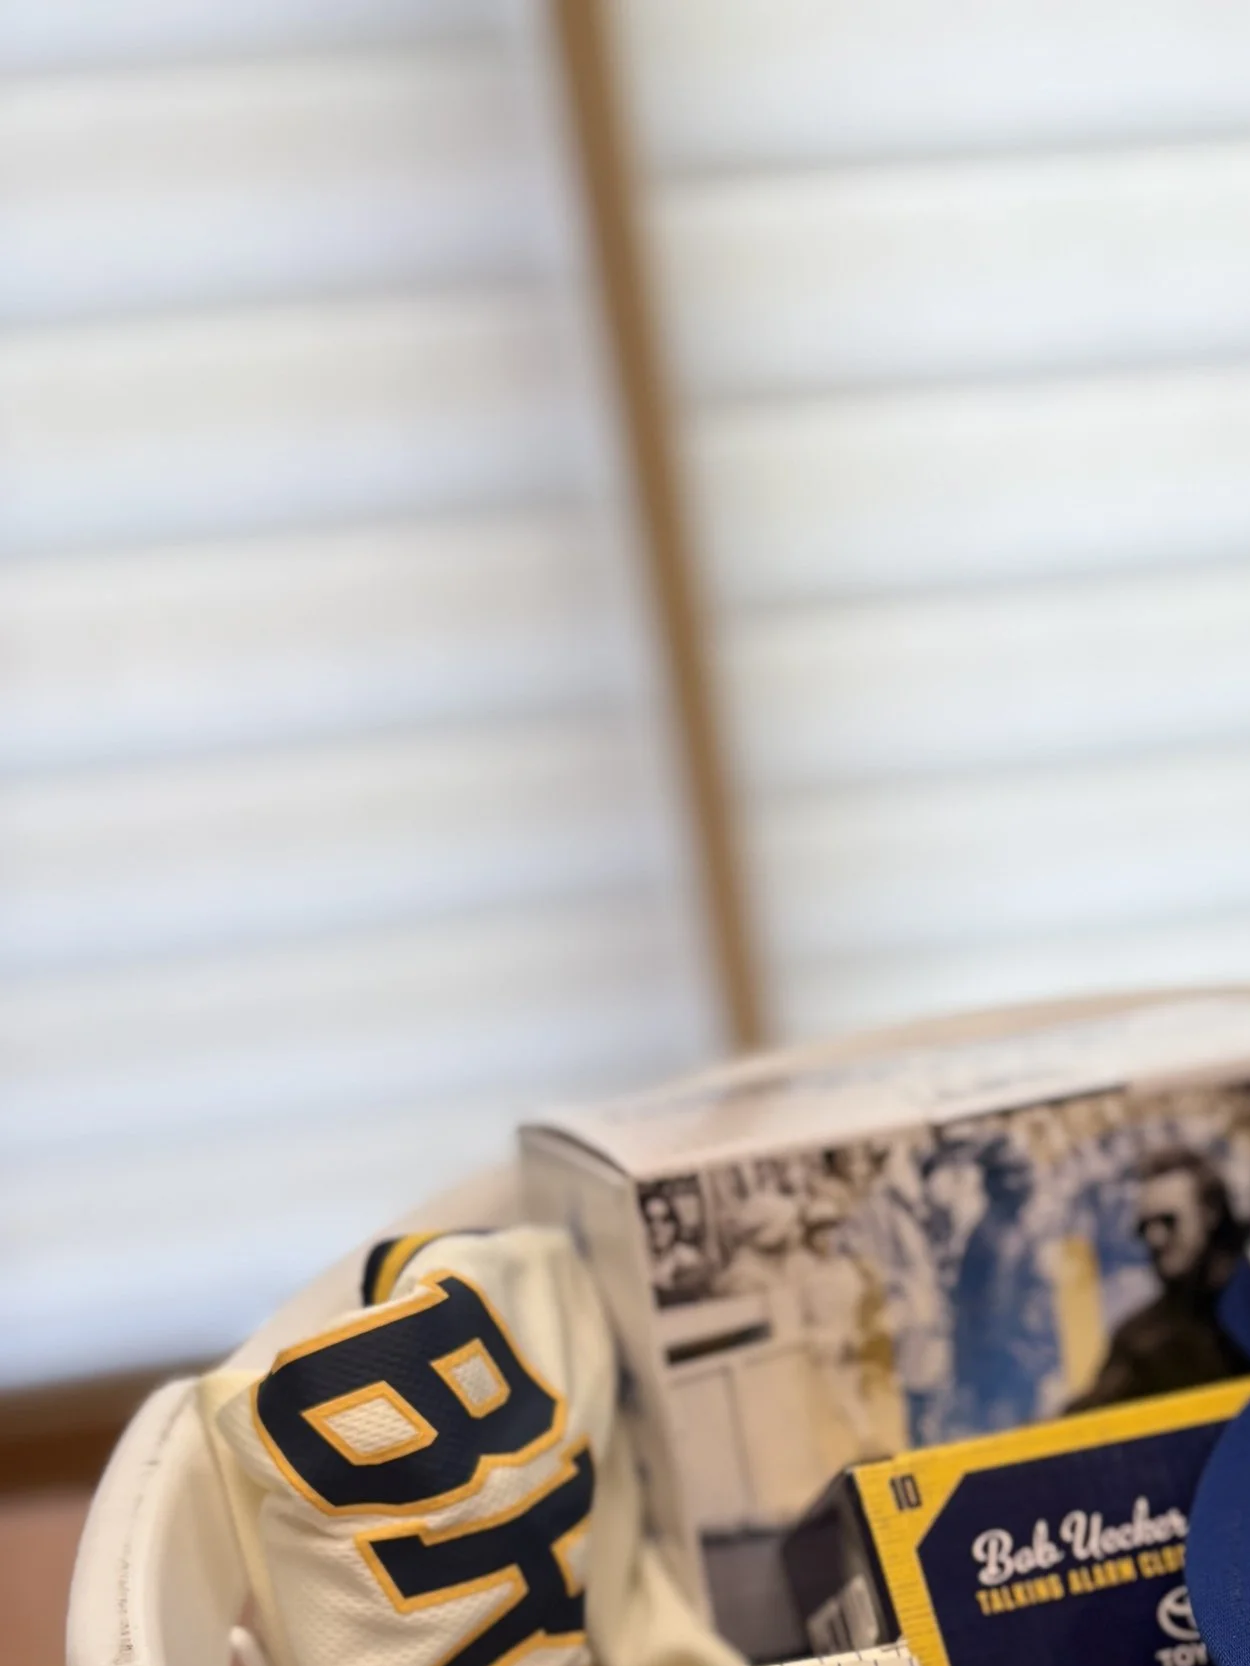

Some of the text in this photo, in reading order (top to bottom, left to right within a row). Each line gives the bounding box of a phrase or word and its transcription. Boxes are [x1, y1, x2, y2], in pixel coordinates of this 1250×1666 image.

[971, 1495, 1189, 1586] Bob Uecker
[976, 1573, 1065, 1616] TALKING
[1067, 1556, 1137, 1596] ALARM
